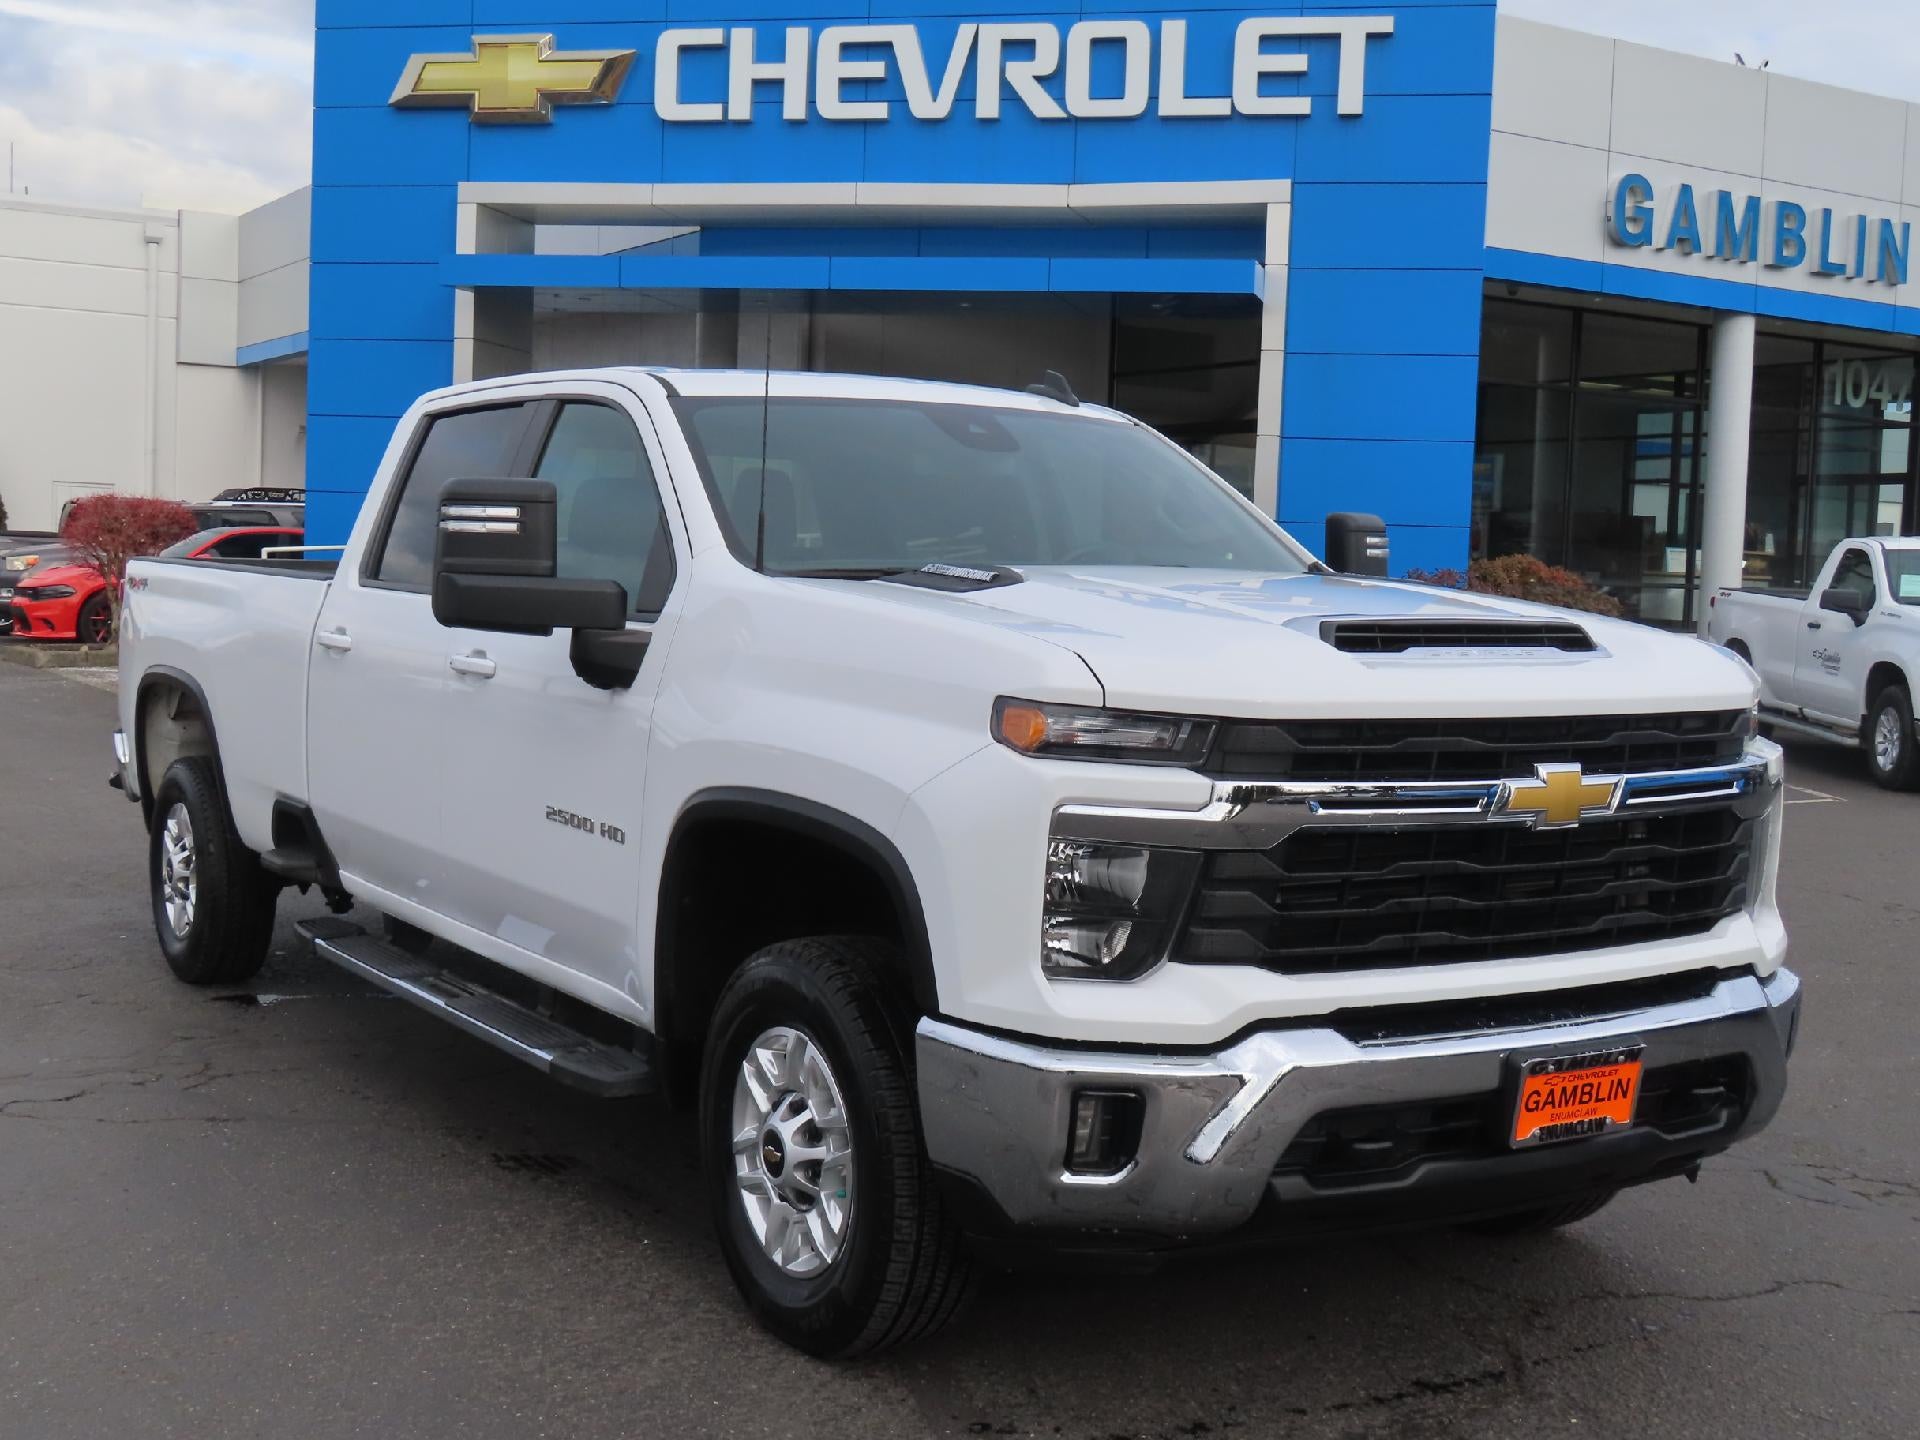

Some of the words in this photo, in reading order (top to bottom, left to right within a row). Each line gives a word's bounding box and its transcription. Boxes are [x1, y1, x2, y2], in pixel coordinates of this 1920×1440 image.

[654, 15, 1395, 123] CHEVROLET
[1608, 173, 1911, 286] GAMBLIN
[546, 805, 594, 834] 2500
[600, 822, 625, 845] HD
[1524, 1078, 1631, 1112] GAMBLIN
[1567, 1069, 1619, 1083] CHEVROLET
